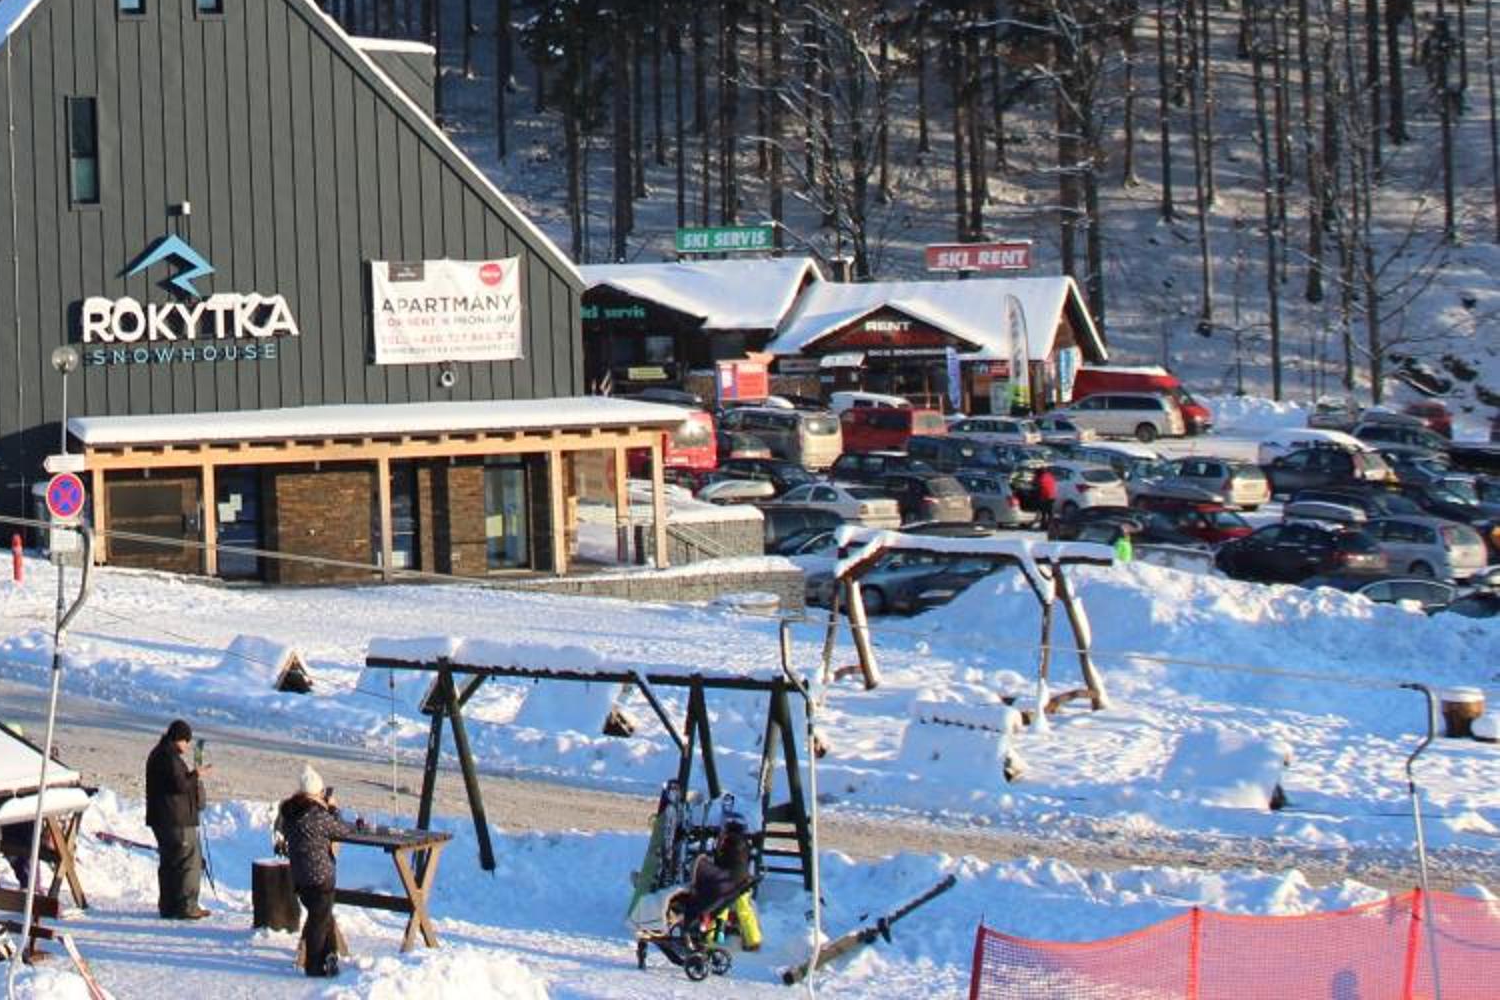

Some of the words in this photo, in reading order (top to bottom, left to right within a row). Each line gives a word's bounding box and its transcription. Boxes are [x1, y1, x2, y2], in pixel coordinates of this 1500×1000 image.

[683, 232, 709, 249] SKI
[713, 230, 767, 247] SERVIS
[937, 251, 969, 267] SKI
[977, 249, 1025, 266] RENT
[83, 292, 299, 342] ROKYTKA
[604, 303, 645, 319] servis
[865, 320, 912, 332] RENT
[93, 343, 277, 365] SNOWHOUSE
